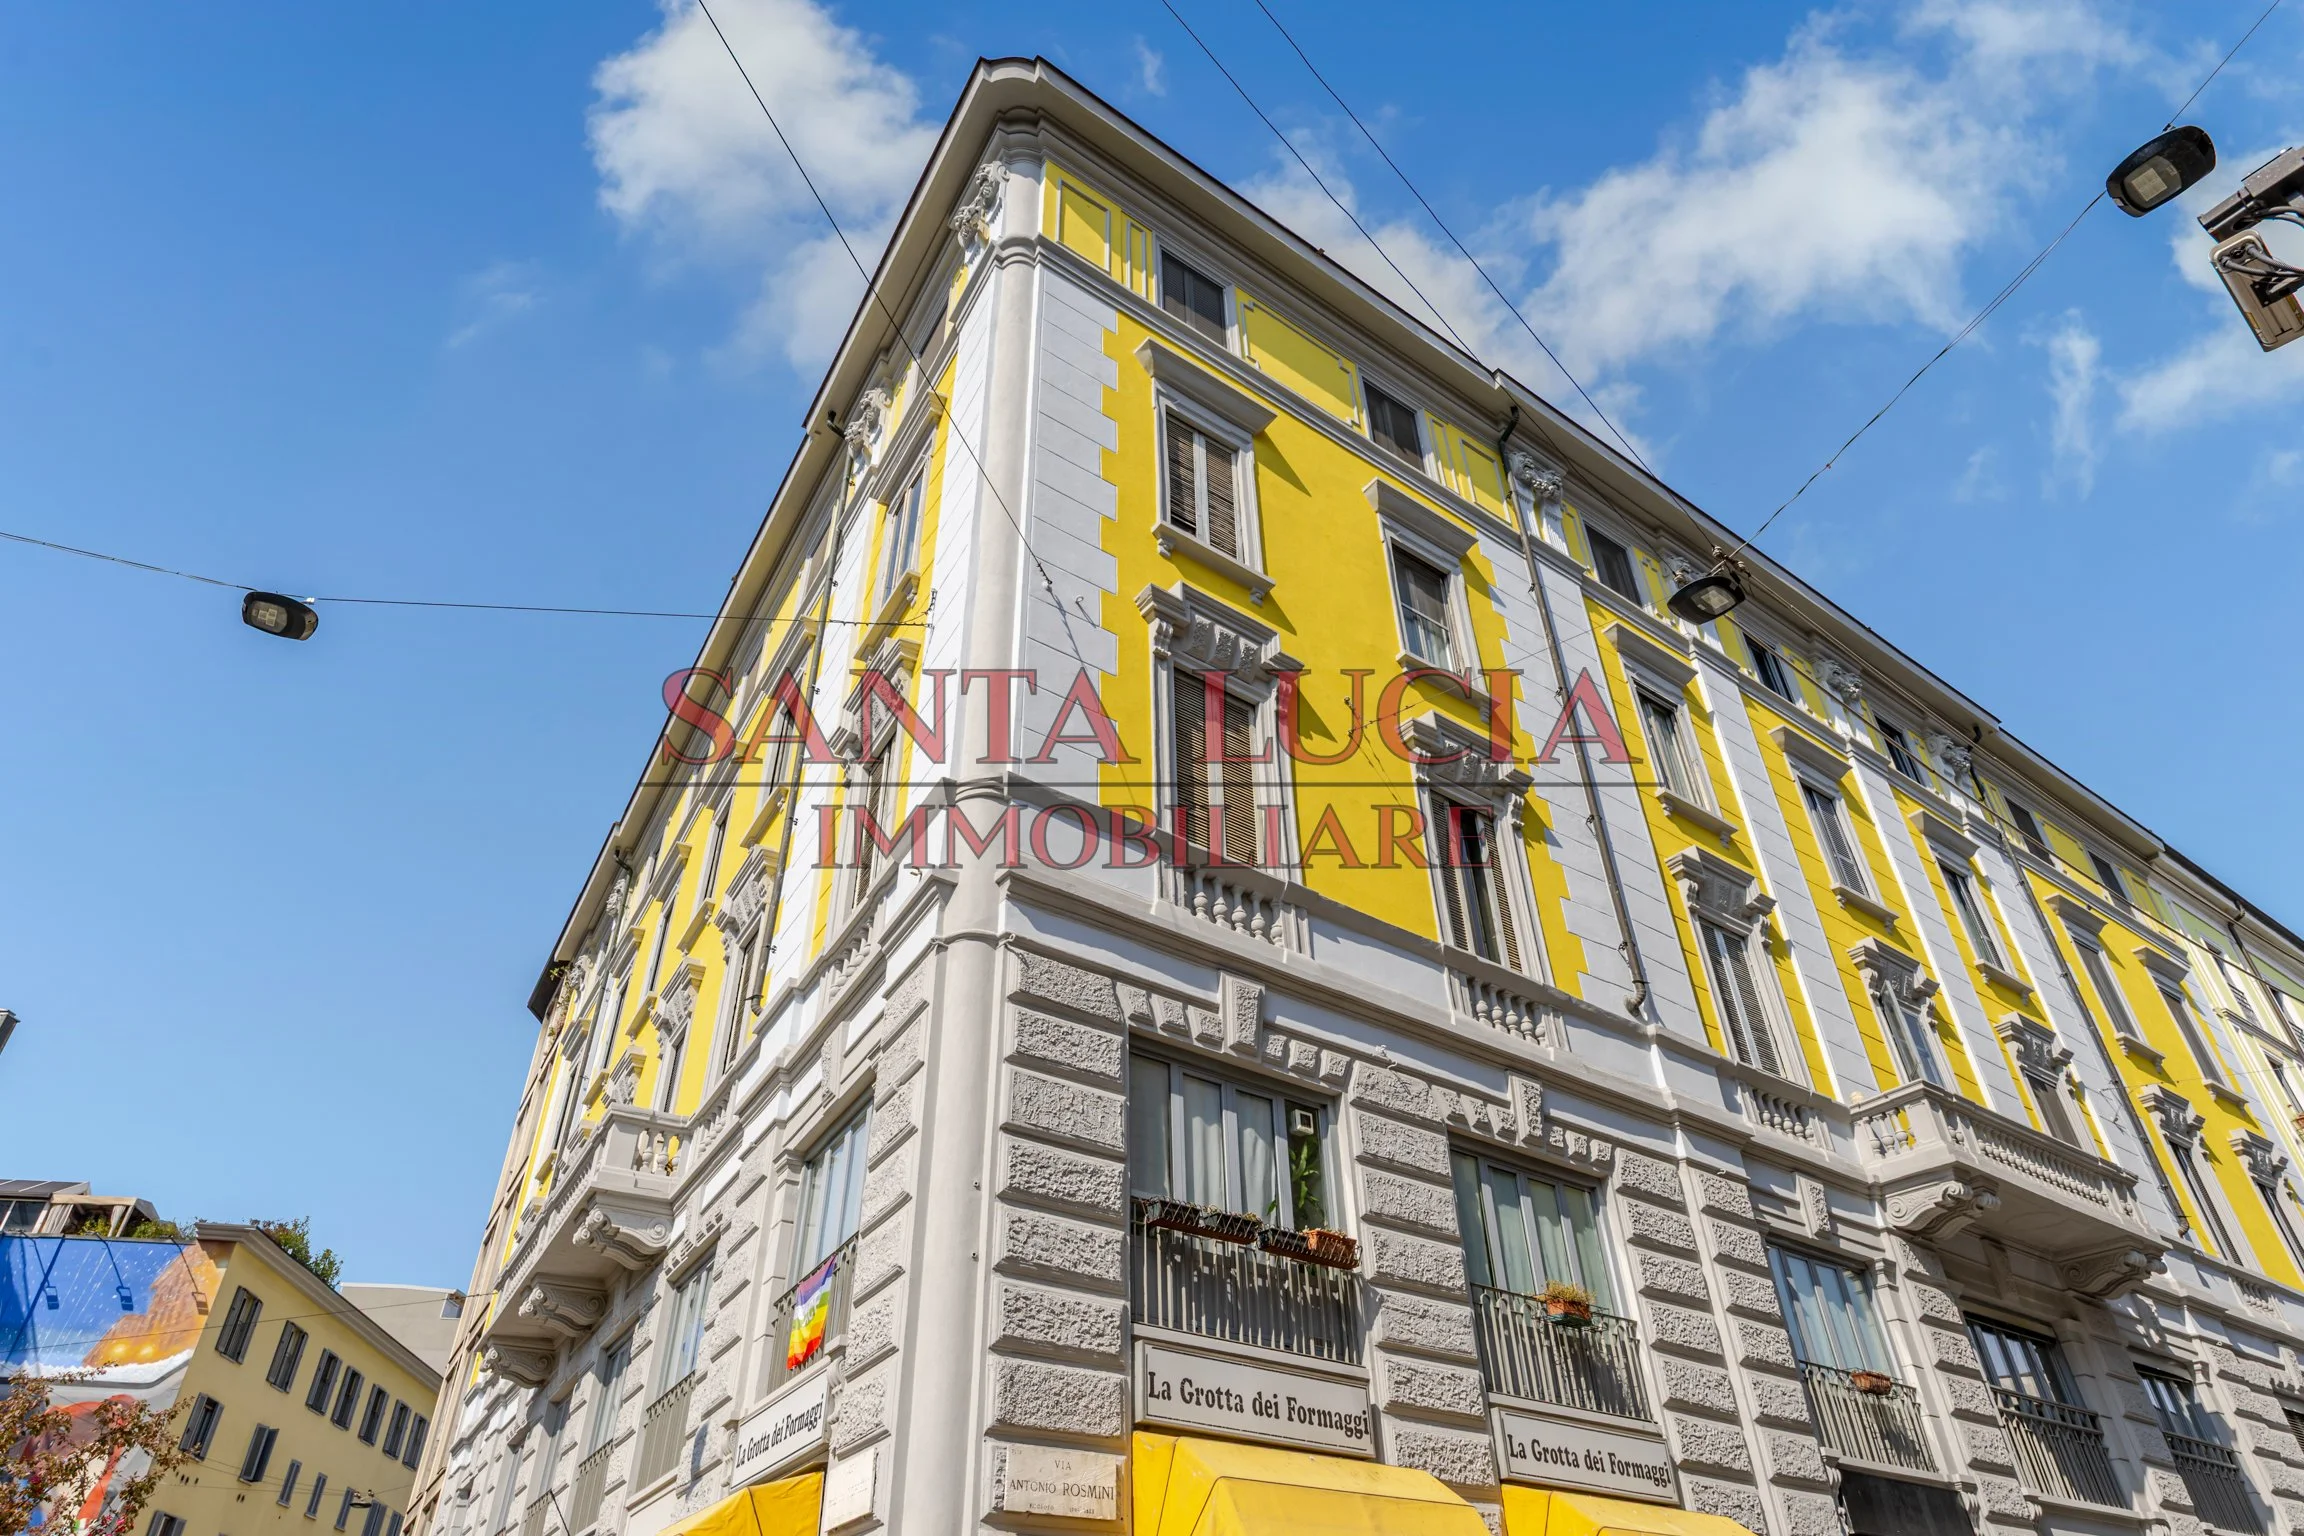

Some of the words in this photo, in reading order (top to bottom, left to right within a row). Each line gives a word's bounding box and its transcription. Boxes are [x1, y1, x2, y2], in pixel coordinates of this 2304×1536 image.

[736, 1443, 746, 1468] La
[747, 1431, 770, 1462] Grotta
[771, 1419, 784, 1448] dei
[783, 1393, 824, 1440] Formaggi
[1148, 1371, 1172, 1401] La
[1180, 1377, 1244, 1414] Grotta
[1252, 1391, 1280, 1420] dei
[1286, 1396, 1370, 1440] Formaggi
[1054, 1459, 1072, 1471] VIA
[1507, 1434, 1527, 1460] La
[1531, 1438, 1580, 1469] Grotta
[1584, 1449, 1606, 1474] dei
[1608, 1452, 1672, 1488] Formaggi
[1009, 1479, 1057, 1494] ANTONIO
[1062, 1482, 1114, 1500] ROSMINI
